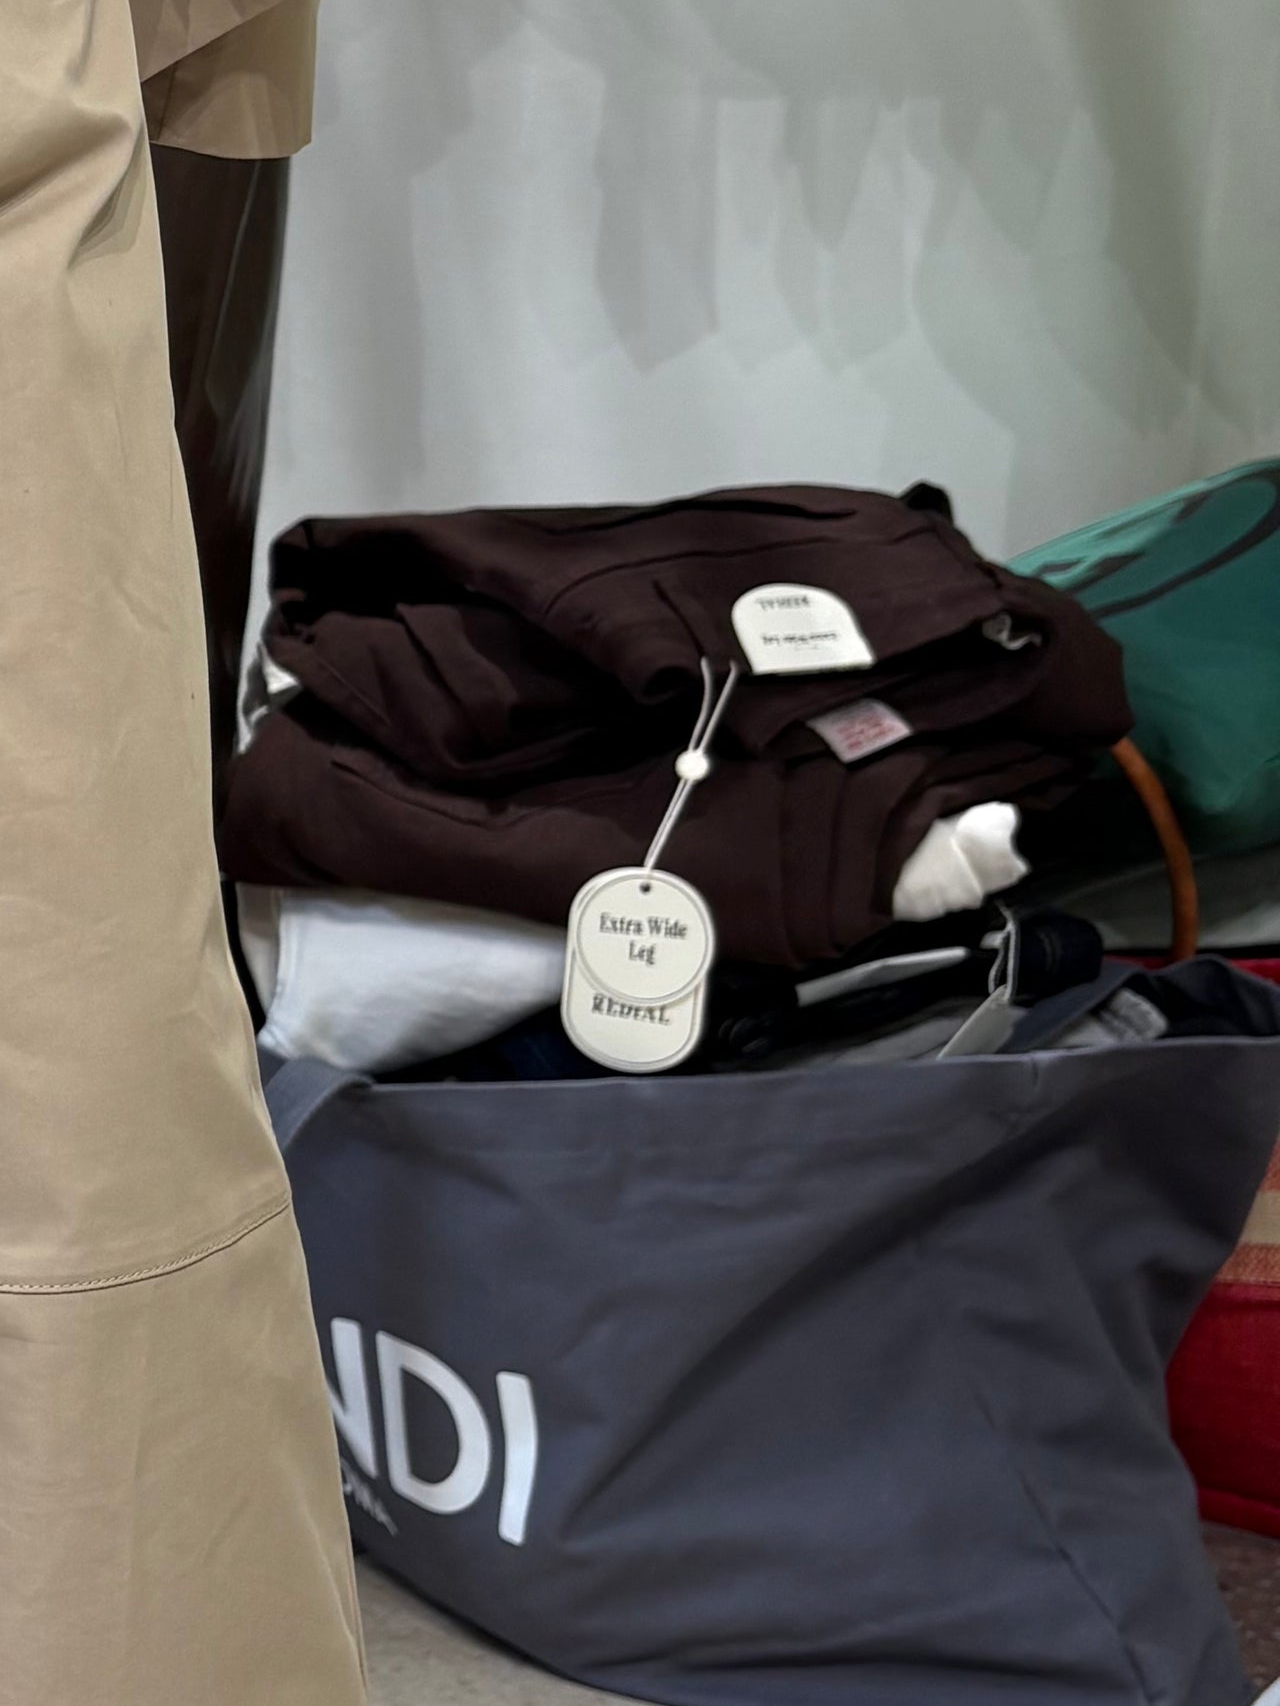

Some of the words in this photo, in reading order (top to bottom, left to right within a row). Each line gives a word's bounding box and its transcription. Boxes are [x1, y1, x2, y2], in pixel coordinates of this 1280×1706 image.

[599, 912, 643, 934] Extra
[648, 916, 688, 939] Wide
[628, 940, 657, 965] Leg
